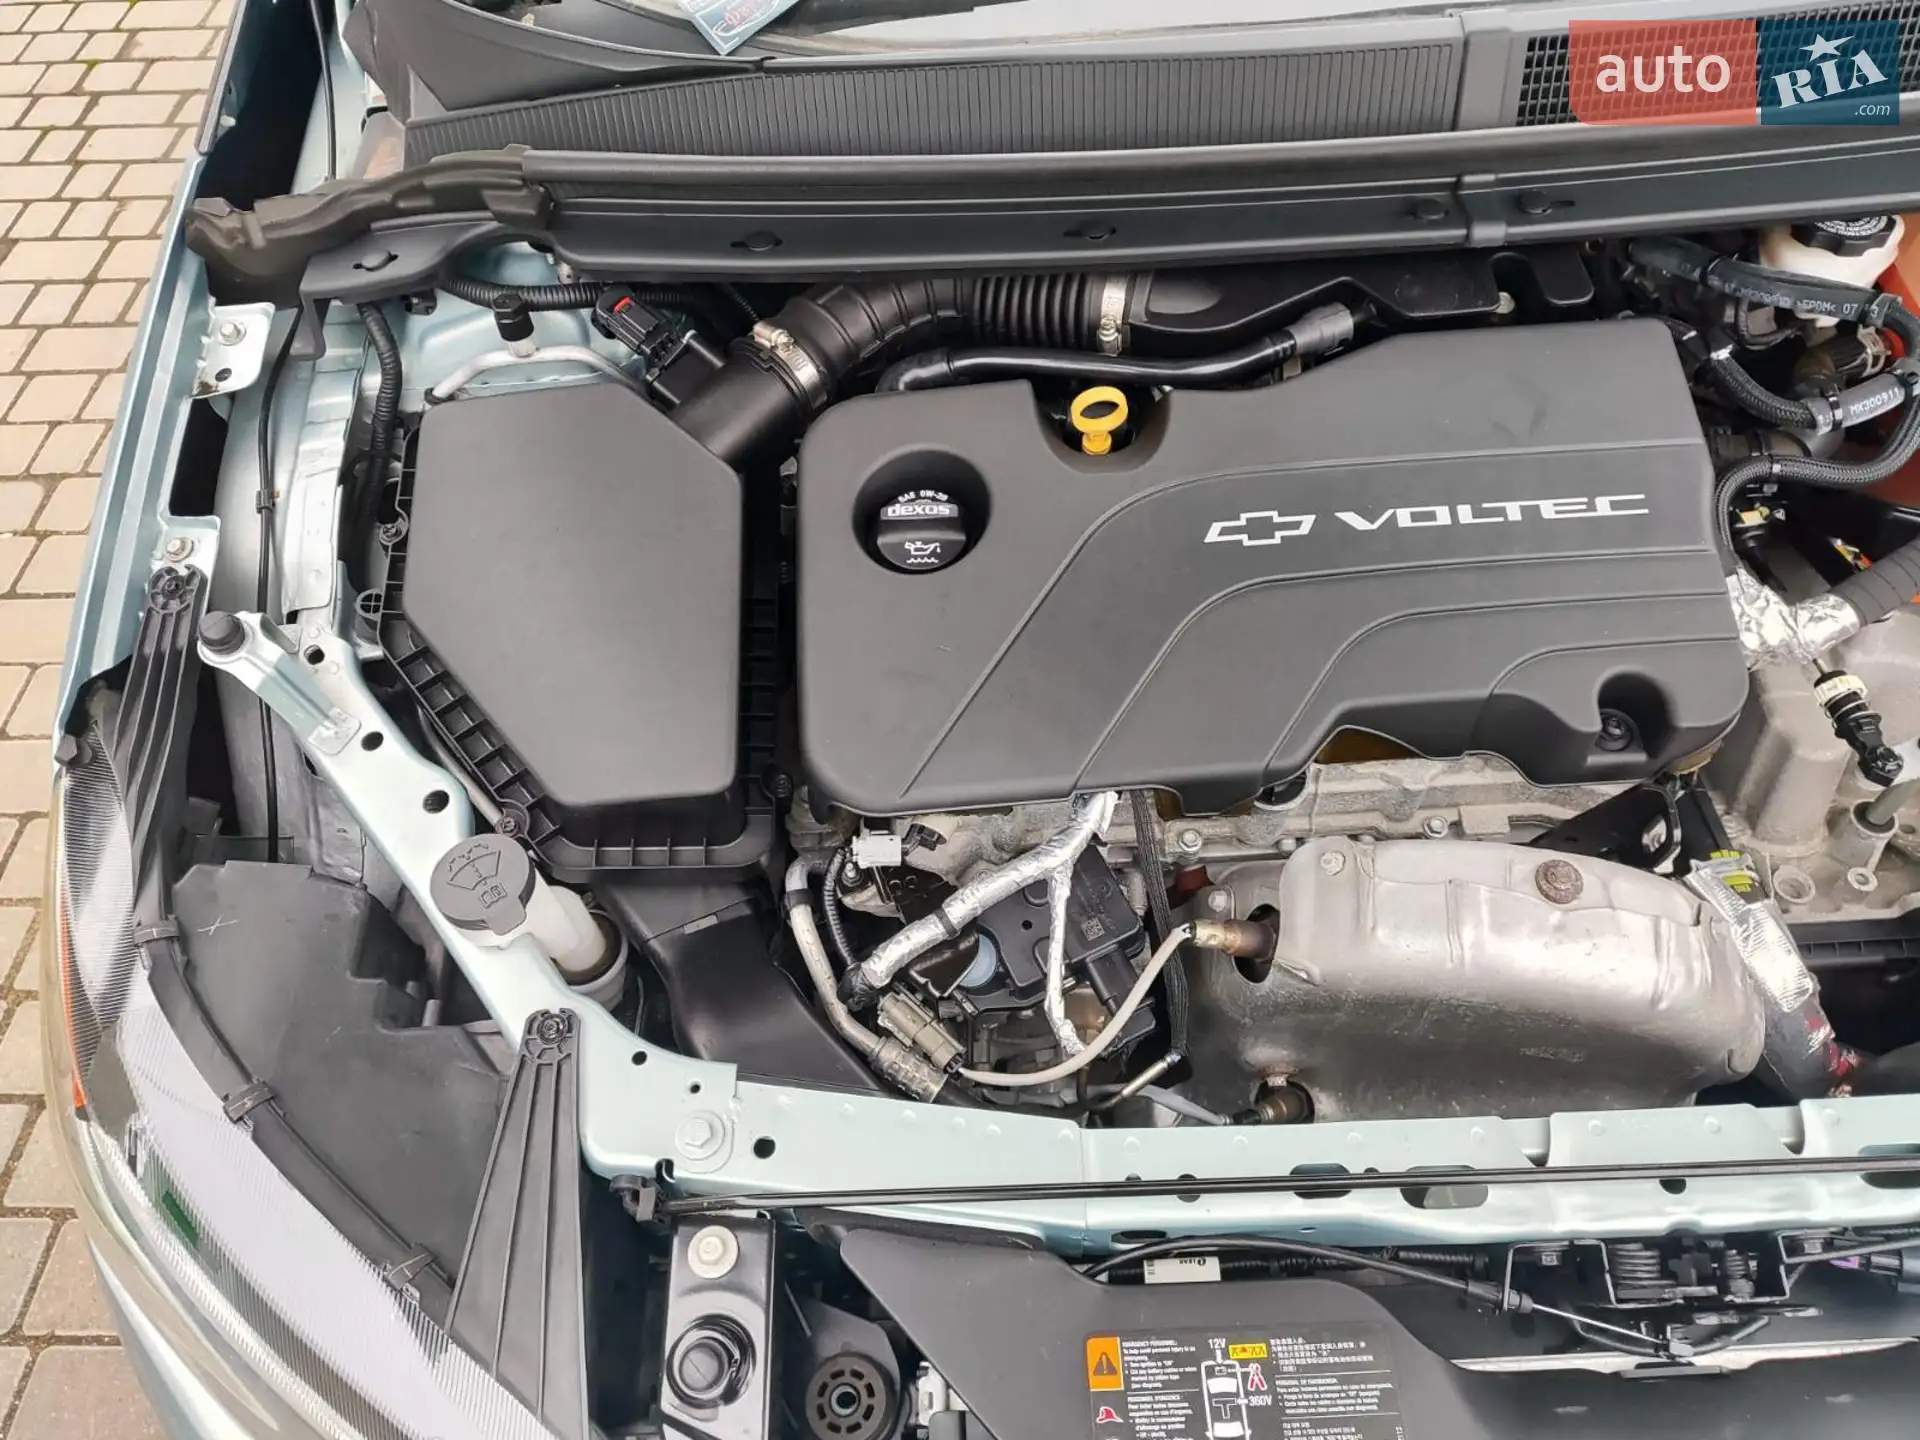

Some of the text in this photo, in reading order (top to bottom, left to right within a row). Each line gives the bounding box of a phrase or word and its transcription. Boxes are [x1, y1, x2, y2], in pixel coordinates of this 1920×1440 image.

[898, 491, 916, 503] SAE
[887, 503, 950, 517] dexos
[1334, 494, 1650, 531] VOLTEC
[1208, 1338, 1226, 1349] 12V
[1248, 1394, 1272, 1406] 360V
